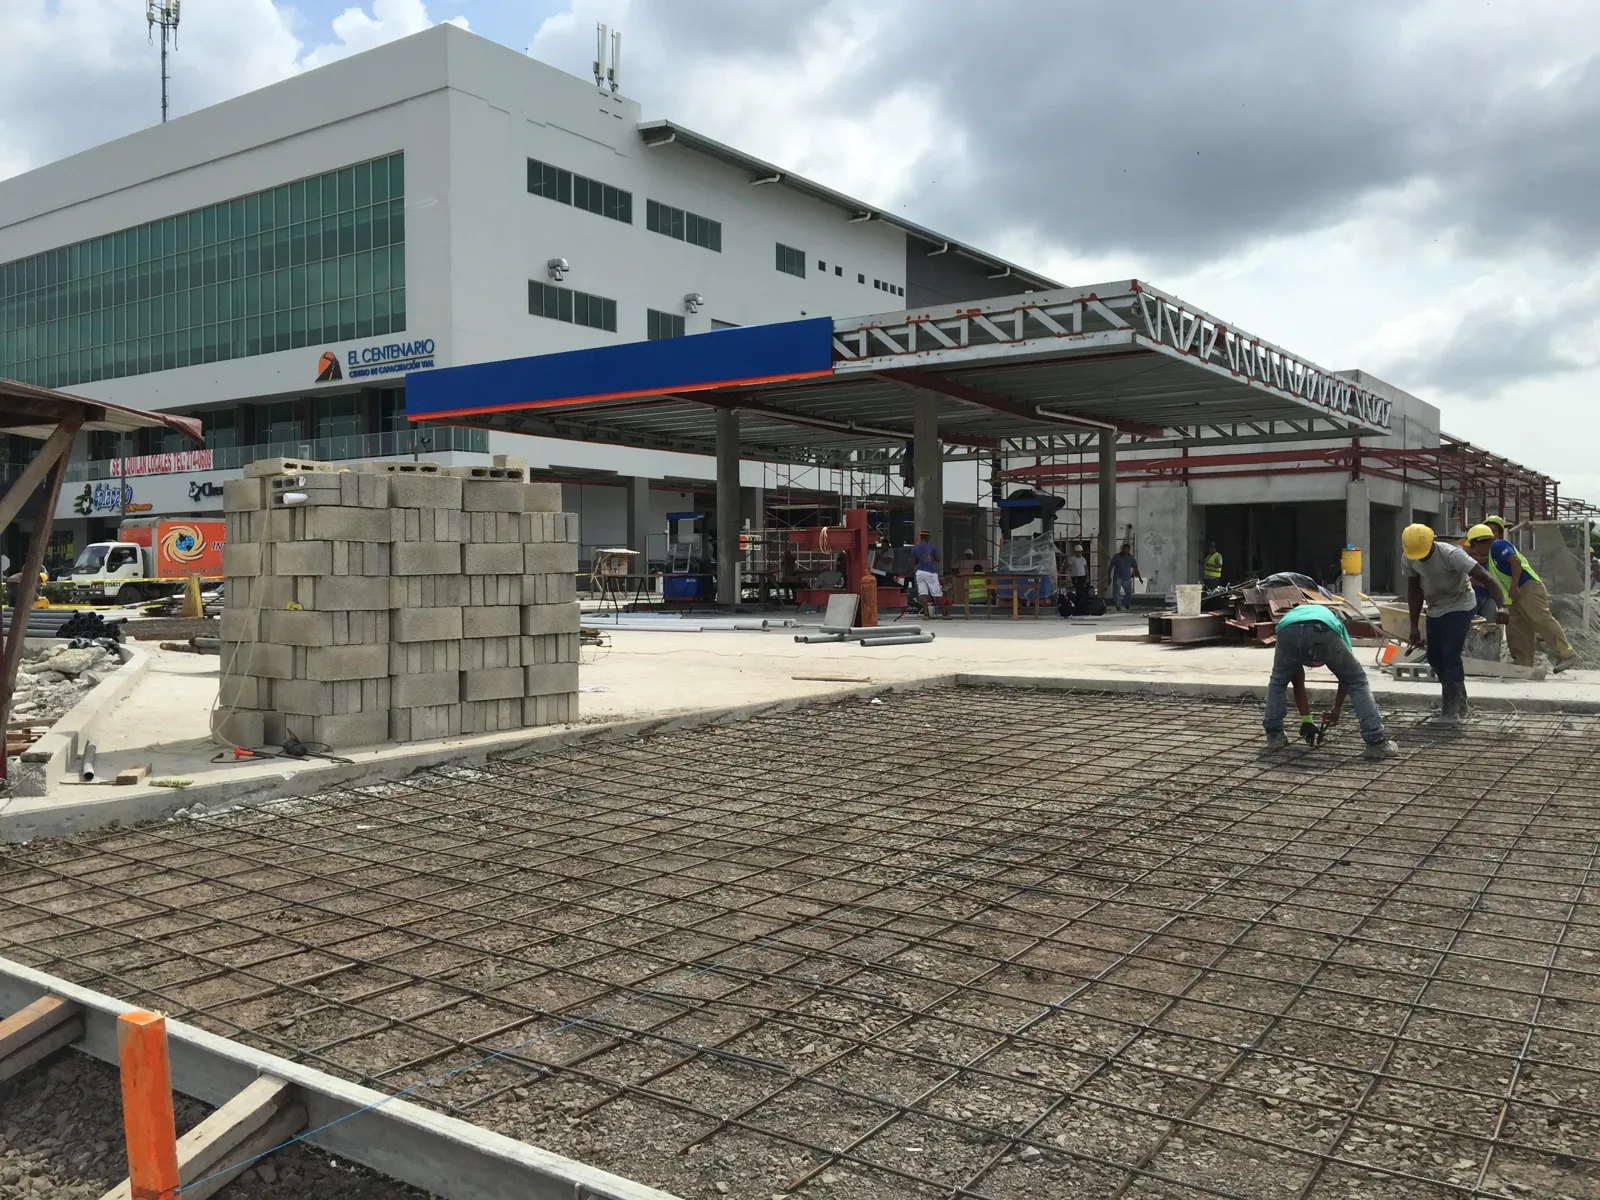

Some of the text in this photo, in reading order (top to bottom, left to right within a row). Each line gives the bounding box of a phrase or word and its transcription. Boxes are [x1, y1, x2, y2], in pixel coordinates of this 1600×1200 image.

[348, 339, 435, 366] EL CENTENARIO
[349, 368, 370, 378] CENTRO
[370, 366, 379, 375] DE
[421, 360, 434, 368] VIAL
[112, 458, 119, 475] SE
[125, 456, 146, 475] LQUILAN
[147, 453, 171, 473] LOCALES
